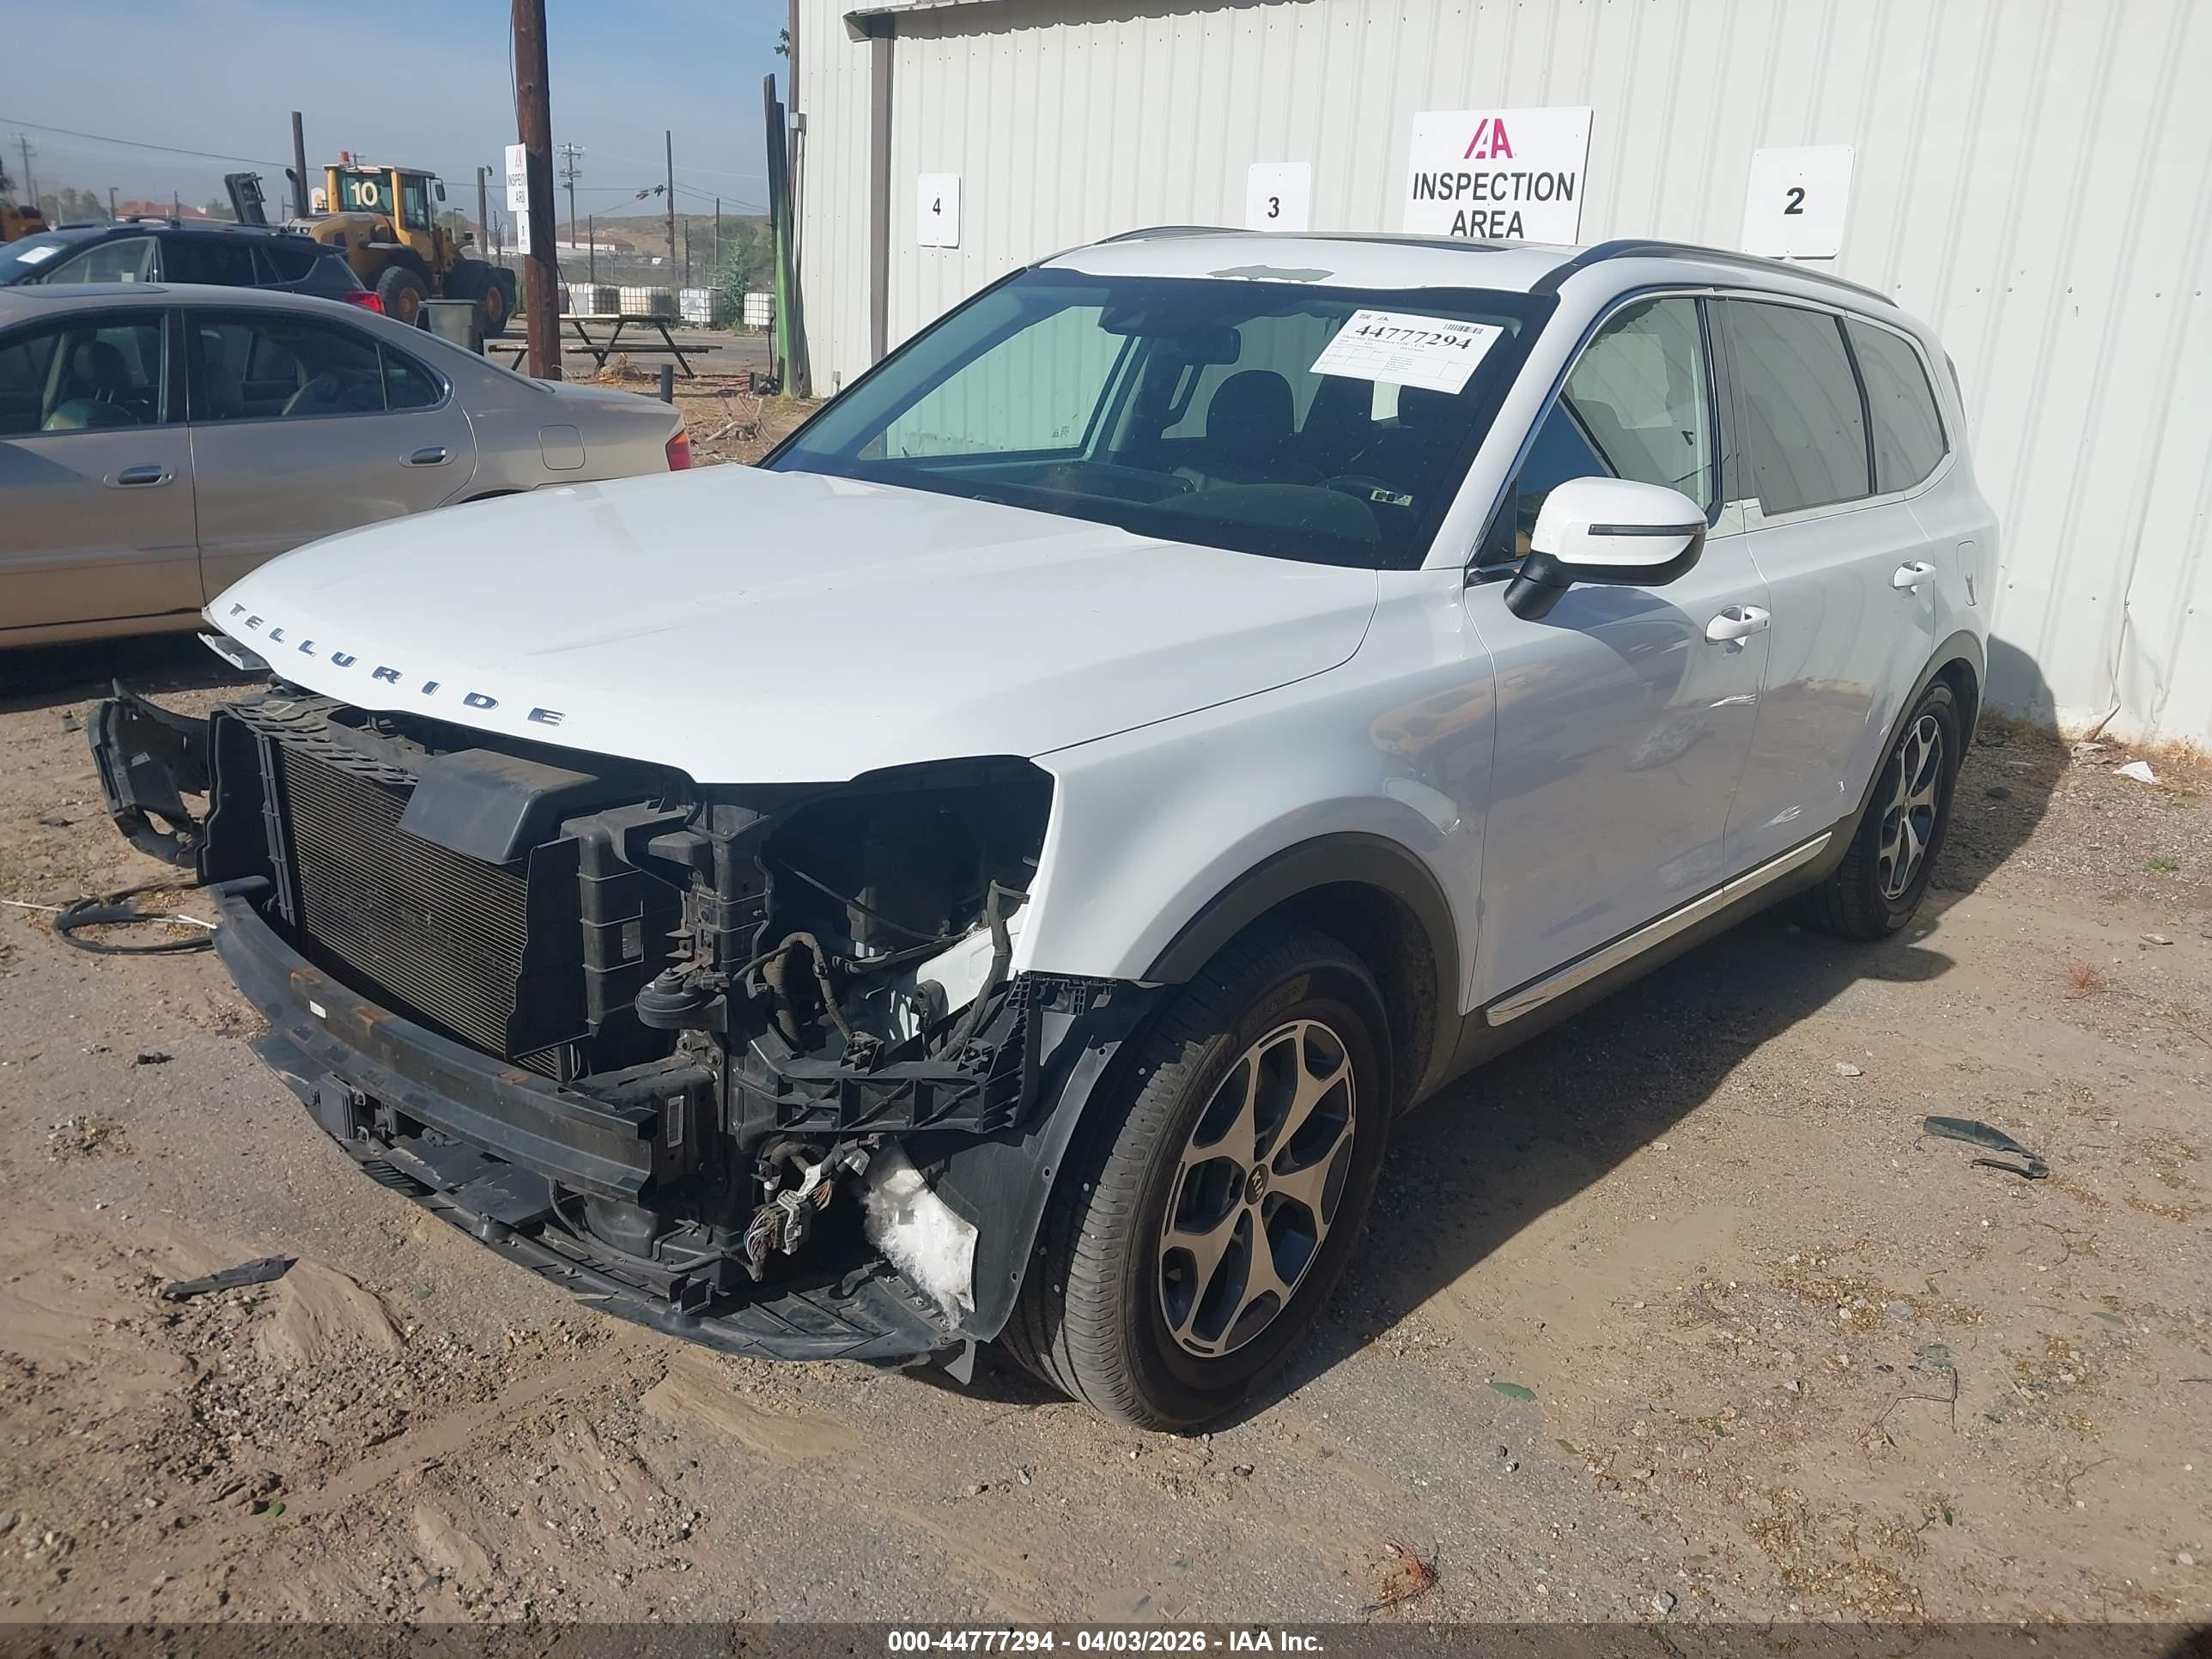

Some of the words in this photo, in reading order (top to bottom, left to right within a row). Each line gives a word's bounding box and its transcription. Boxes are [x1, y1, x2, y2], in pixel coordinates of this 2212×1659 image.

[350, 181, 378, 206] 10
[1413, 172, 1576, 201] INSPECTION
[933, 197, 941, 216] 4
[1267, 196, 1279, 218] 3
[1784, 187, 1806, 215] 2
[1449, 209, 1525, 240] AREA
[1355, 324, 1473, 350] 44777294
[229, 603, 567, 727] TELLURIDE
[1252, 1170, 1263, 1200] KIA
